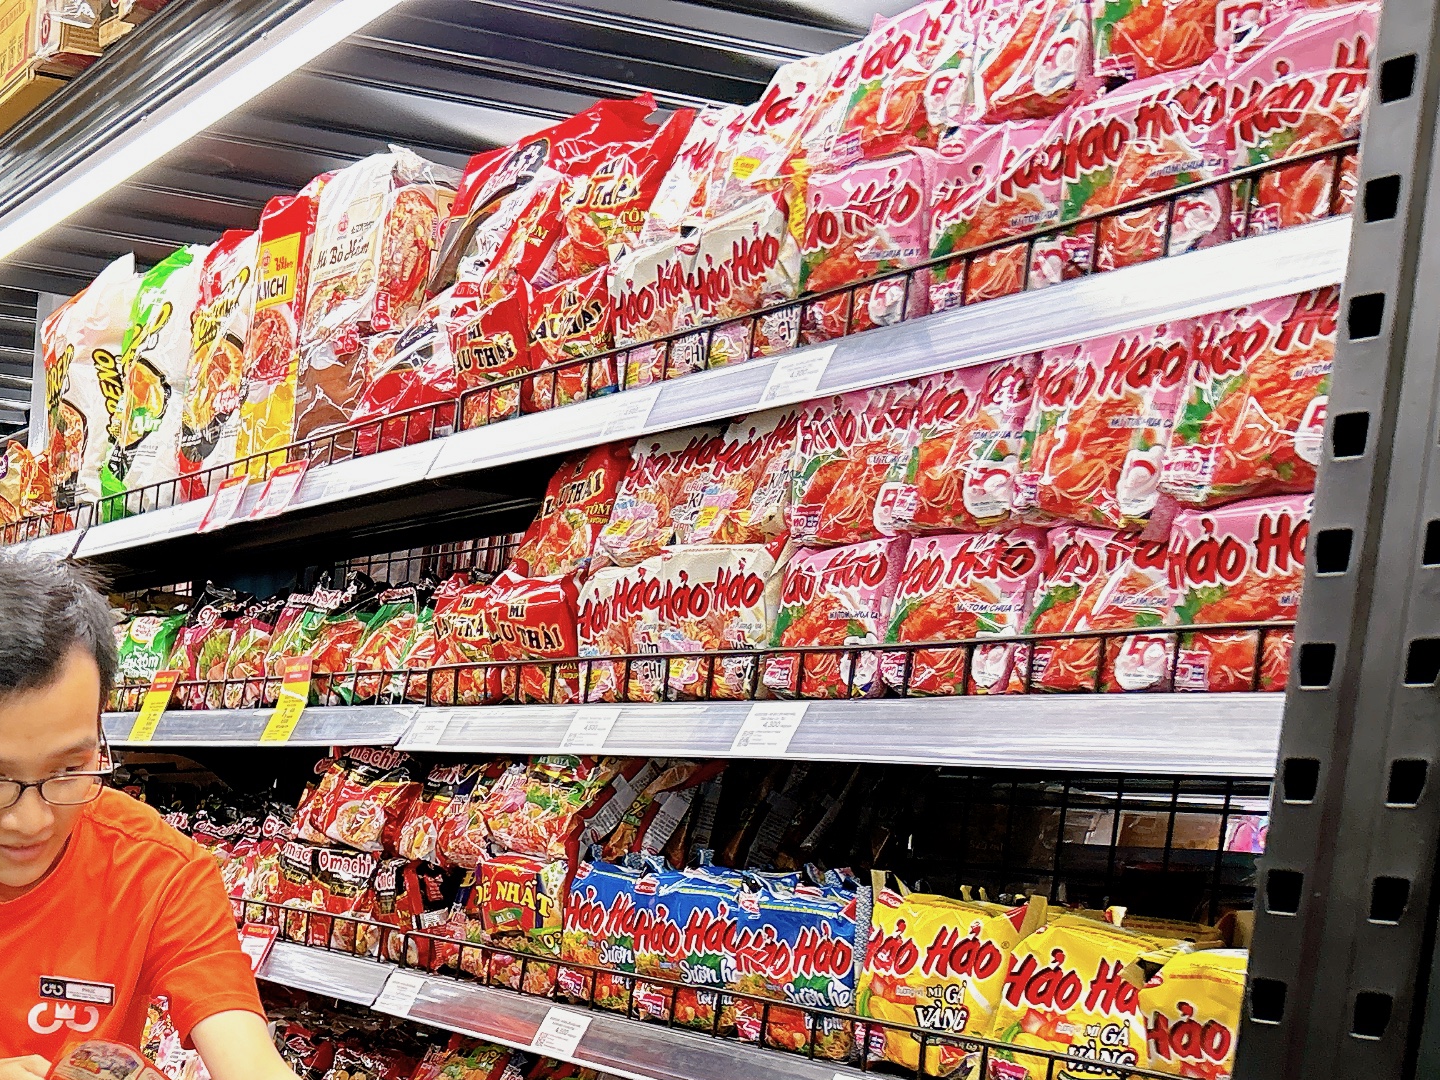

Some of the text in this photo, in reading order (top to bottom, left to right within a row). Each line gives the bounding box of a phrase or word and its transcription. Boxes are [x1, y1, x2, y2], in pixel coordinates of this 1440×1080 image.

[732, 221, 779, 288] Hảo
[660, 557, 765, 624] Hảo Hảo
[515, 620, 564, 651] THÁI
[318, 849, 373, 879] Omachi
[495, 879, 554, 918] NHẤT
[566, 888, 606, 934] Hảo
[634, 908, 680, 956] Hảo
[794, 920, 852, 977] Hảo
[922, 919, 1002, 980] Hảo
[783, 981, 827, 1006] Sườn
[926, 978, 967, 1005] MÌ GÀ
[1002, 948, 1082, 1014] Hảo
[915, 999, 969, 1034] VÀNG
[1085, 1018, 1131, 1046] MÌ GÀ
[1146, 1001, 1231, 1064] Hảo
